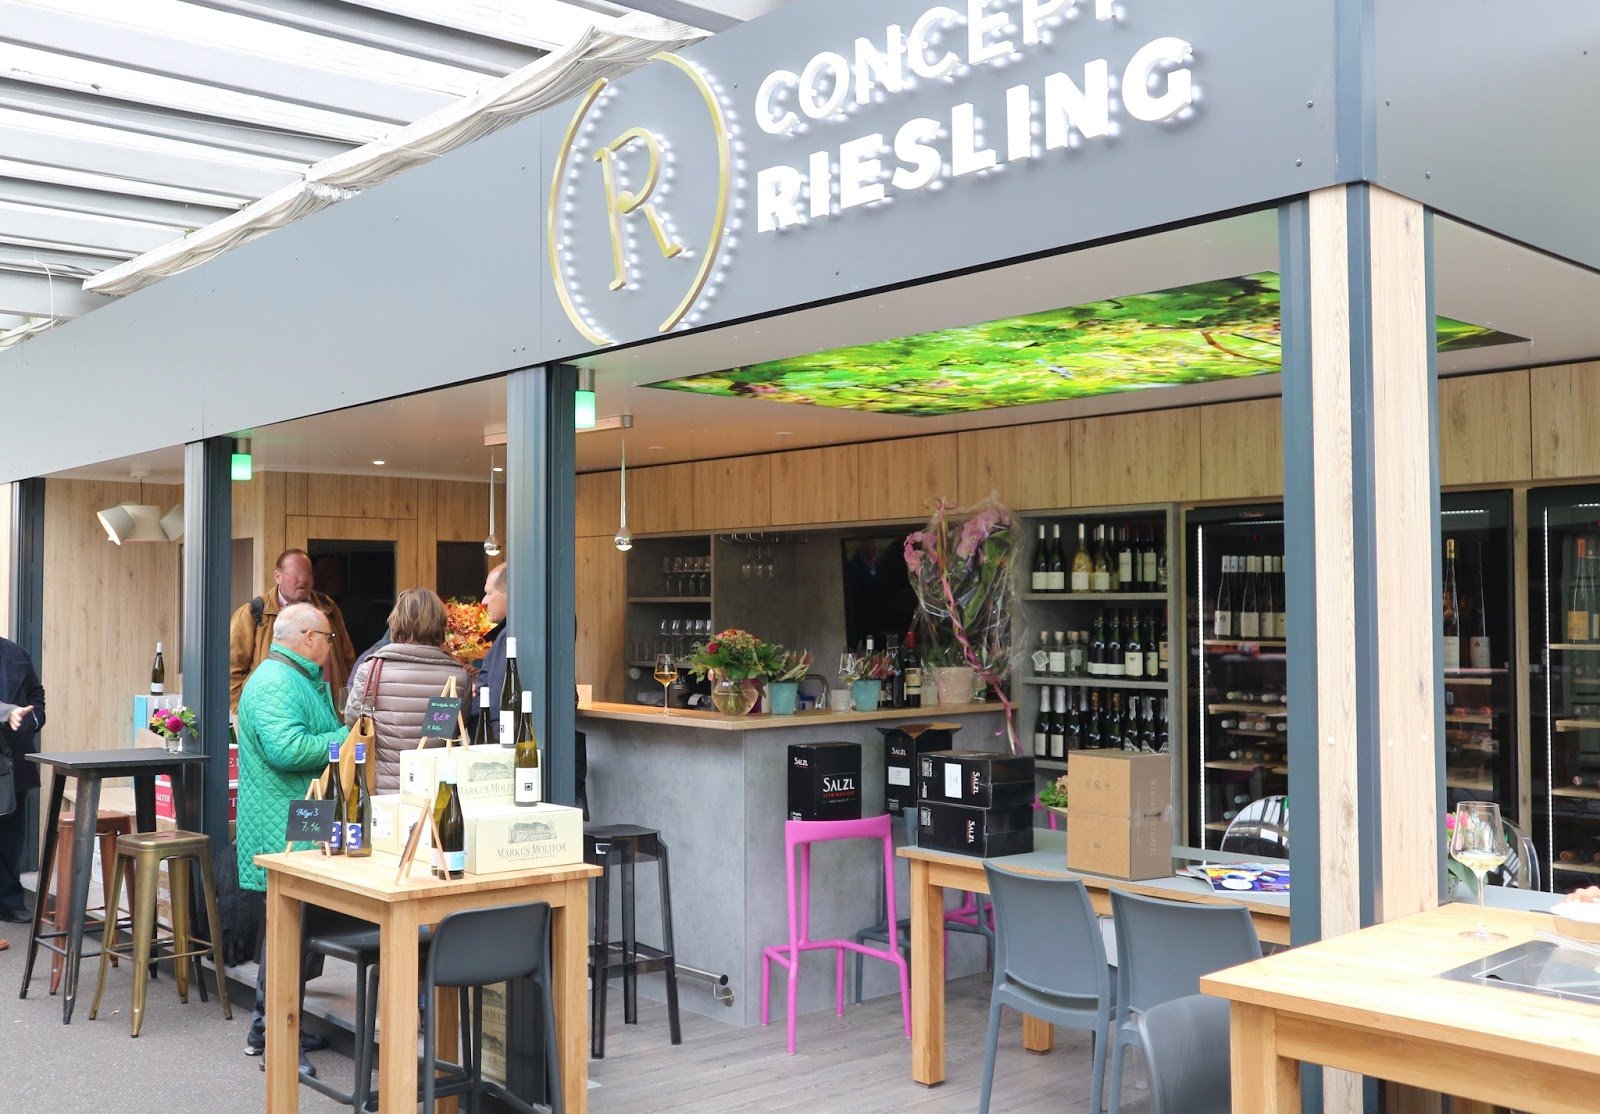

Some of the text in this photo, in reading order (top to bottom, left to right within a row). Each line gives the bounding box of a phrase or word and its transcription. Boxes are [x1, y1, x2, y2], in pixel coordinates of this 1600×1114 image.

[754, 0, 1114, 134] CONCEP
[757, 37, 1193, 233] RIESLING
[593, 127, 683, 291] R
[793, 756, 809, 767] SALZL
[823, 777, 855, 793] SALZL
[972, 771, 981, 795] SALZL
[968, 820, 976, 844] SALZL
[497, 847, 531, 859] MARKUS
[532, 843, 567, 855] MOLITOR
